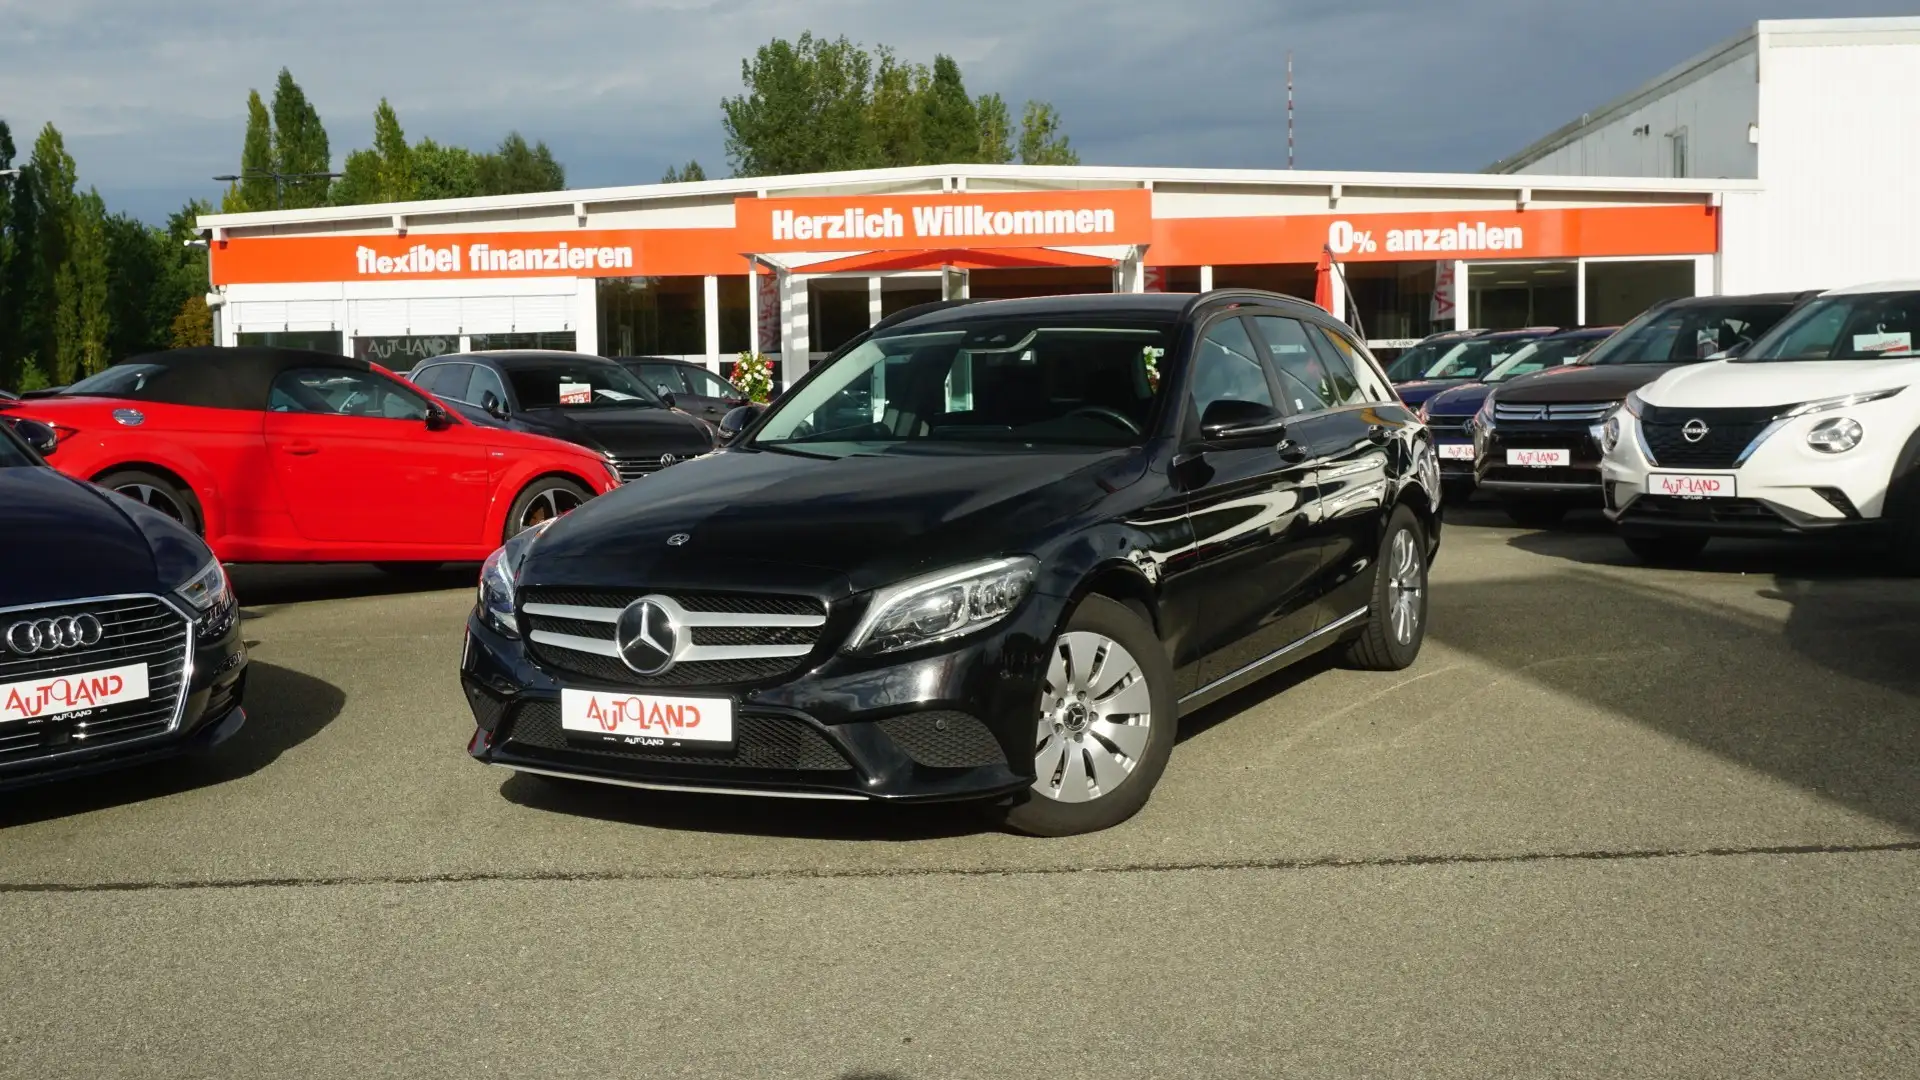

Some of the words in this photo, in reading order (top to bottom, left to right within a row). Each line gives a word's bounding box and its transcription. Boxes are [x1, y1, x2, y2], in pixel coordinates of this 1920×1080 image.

[772, 208, 904, 240] Herzlich
[912, 205, 1115, 237] Willkommen
[1328, 220, 1377, 254] 0%
[1386, 221, 1523, 252] anzahlen
[356, 244, 461, 274] flexibel
[469, 242, 633, 271] finanzieren
[1663, 477, 1720, 494] AUTOLAND
[5, 675, 123, 716] AUTOLAND
[587, 696, 701, 735] AUTOLAND
[624, 736, 664, 746] AUTOLAND
